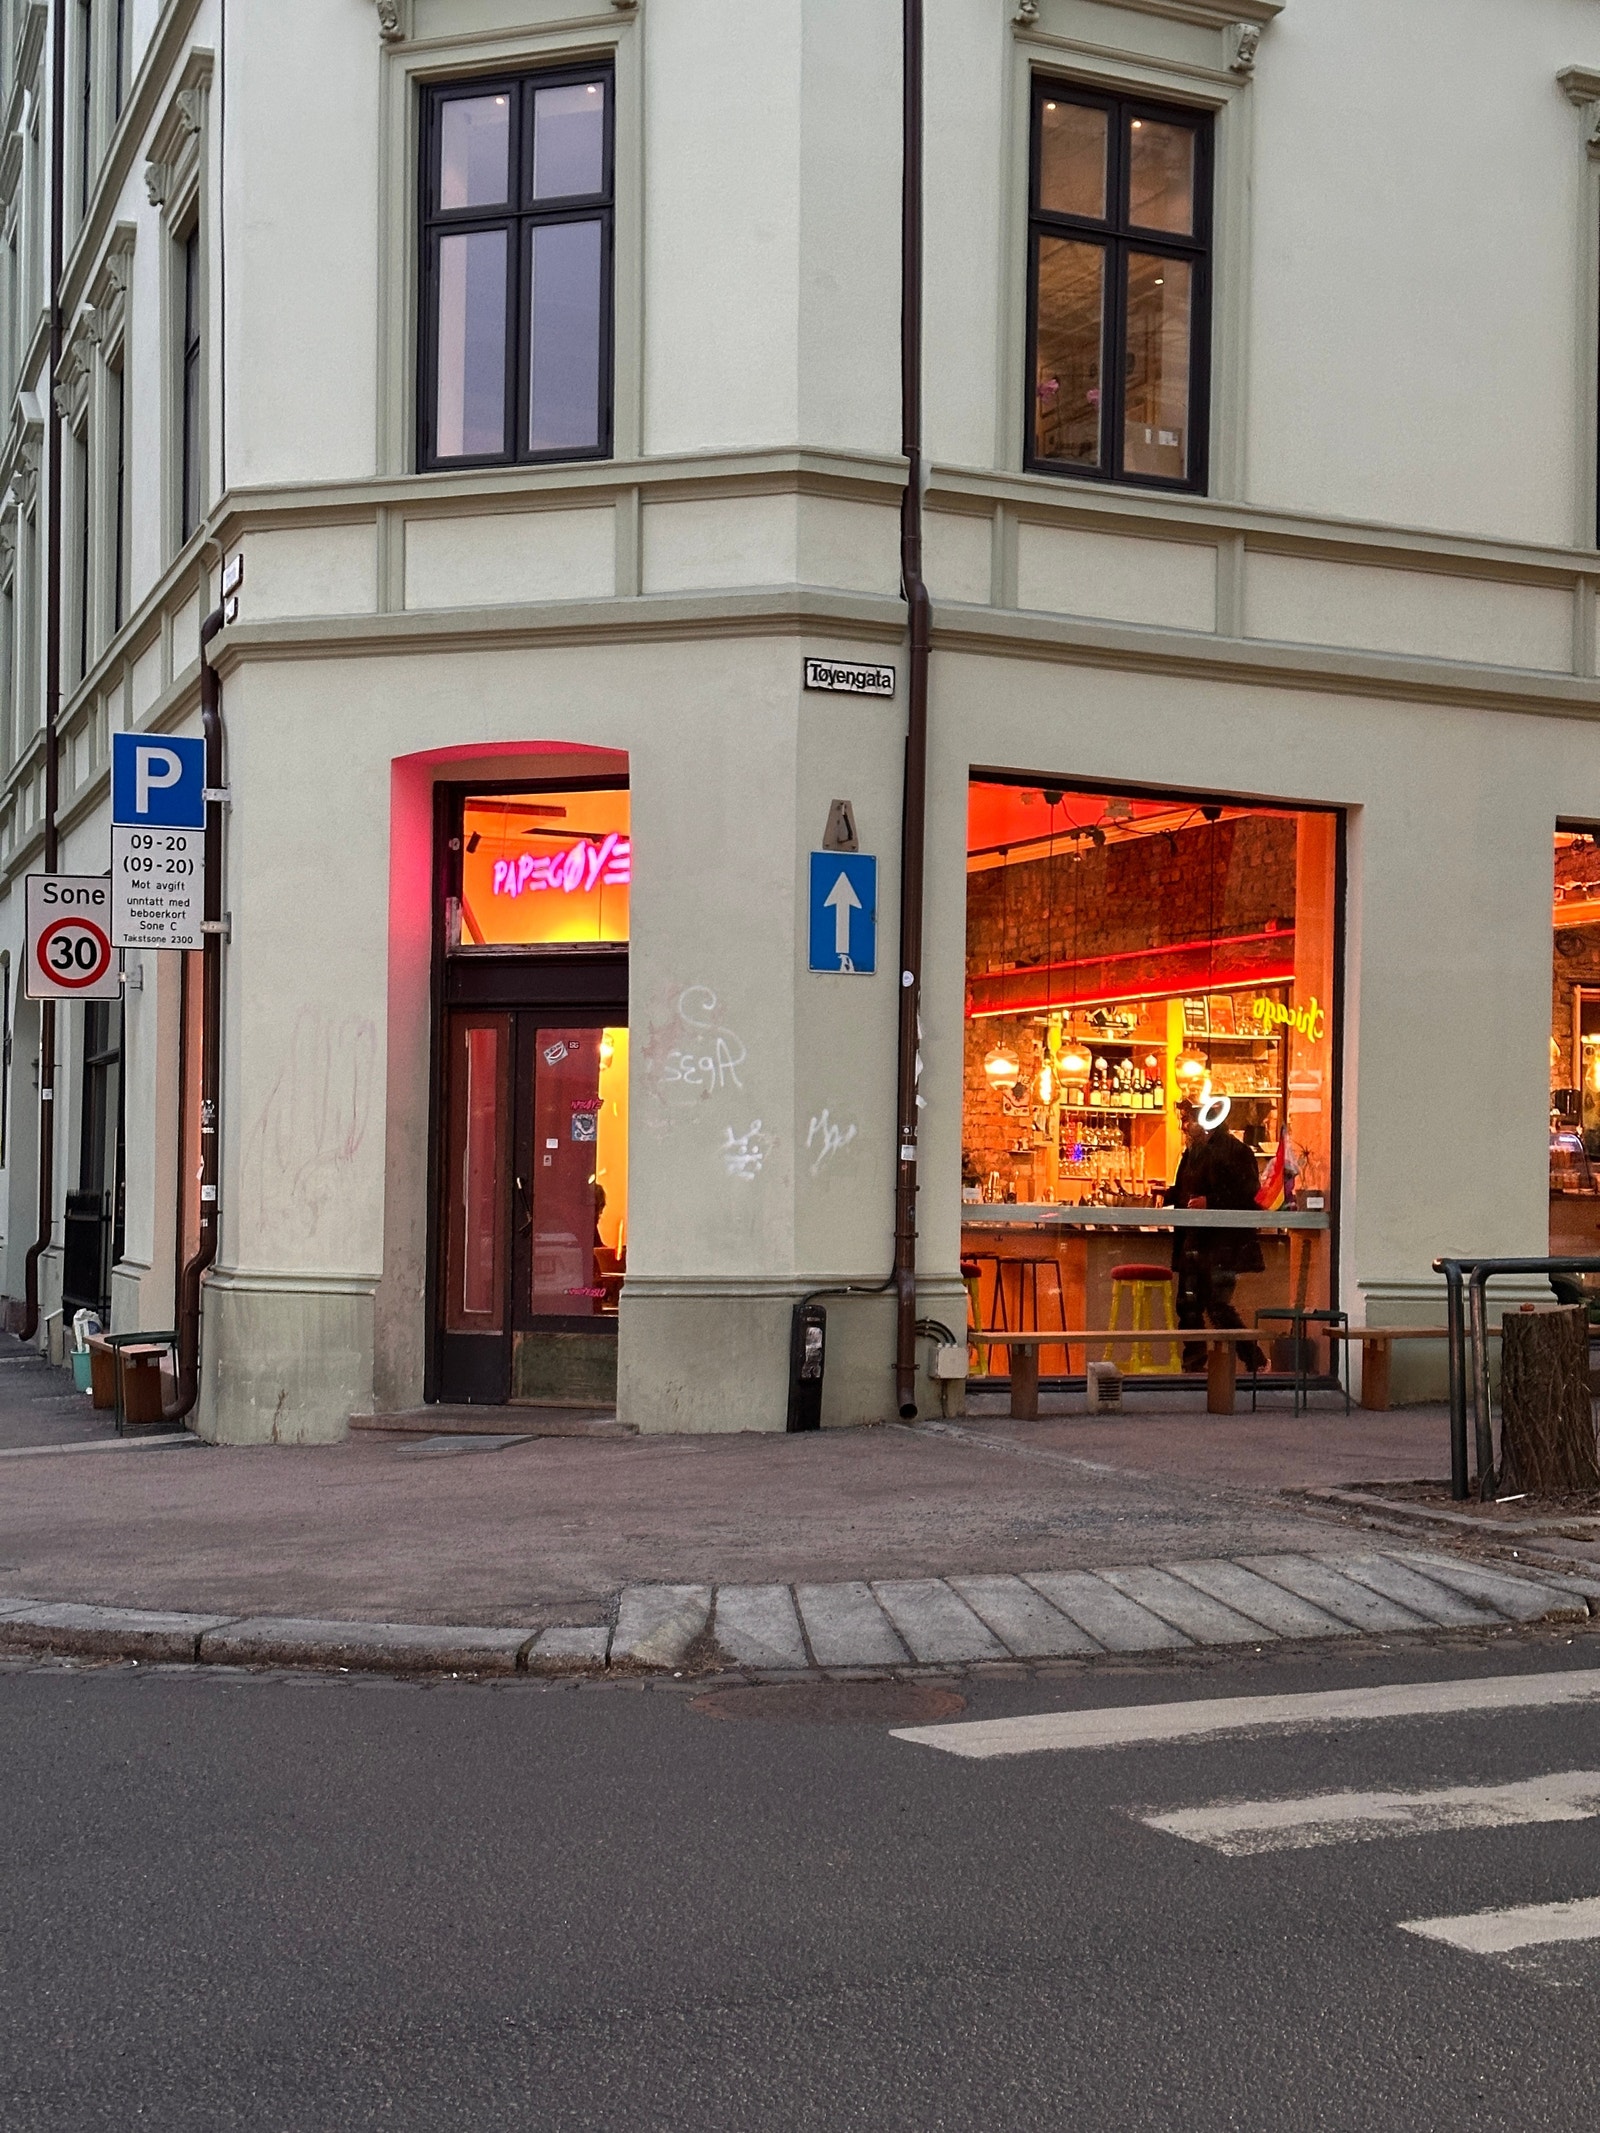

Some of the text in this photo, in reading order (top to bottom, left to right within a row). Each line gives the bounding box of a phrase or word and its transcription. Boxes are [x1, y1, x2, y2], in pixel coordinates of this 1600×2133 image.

[810, 663, 892, 689] Tøyengata
[135, 746, 183, 814] P
[131, 879, 185, 893] Mot avgift
[43, 882, 106, 905] Sone
[126, 896, 190, 908] unntatt med
[130, 908, 186, 919] beboerkort
[139, 920, 177, 931] Sone C
[123, 933, 194, 944] Takstsone 2300
[51, 936, 98, 970] 30
